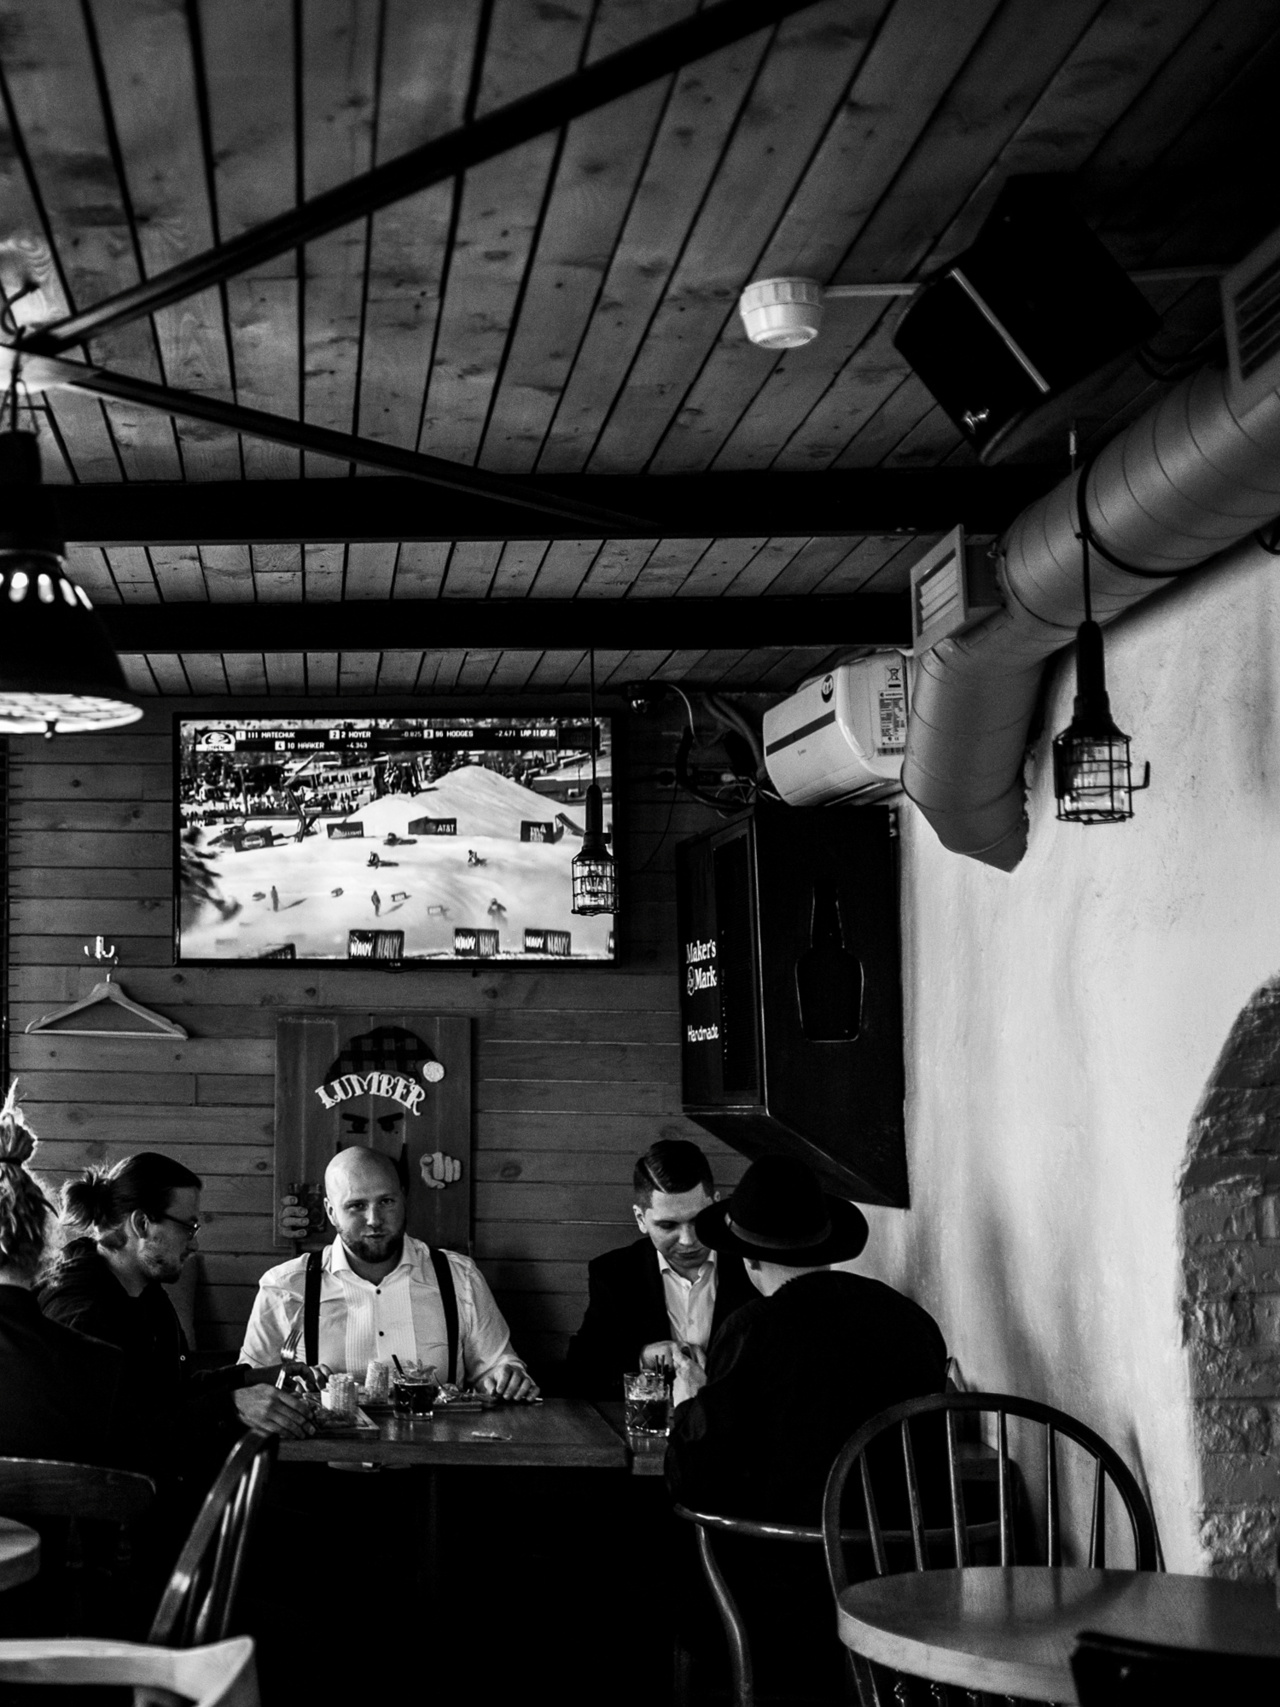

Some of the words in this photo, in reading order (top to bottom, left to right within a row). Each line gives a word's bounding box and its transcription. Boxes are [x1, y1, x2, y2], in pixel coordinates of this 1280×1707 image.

[446, 730, 474, 738] HODGES
[520, 729, 532, 737] LAP
[436, 824, 455, 833] AT&T
[686, 939, 717, 964] Maker's
[687, 1023, 719, 1042] Handmade
[315, 1072, 426, 1116] LUMBER
